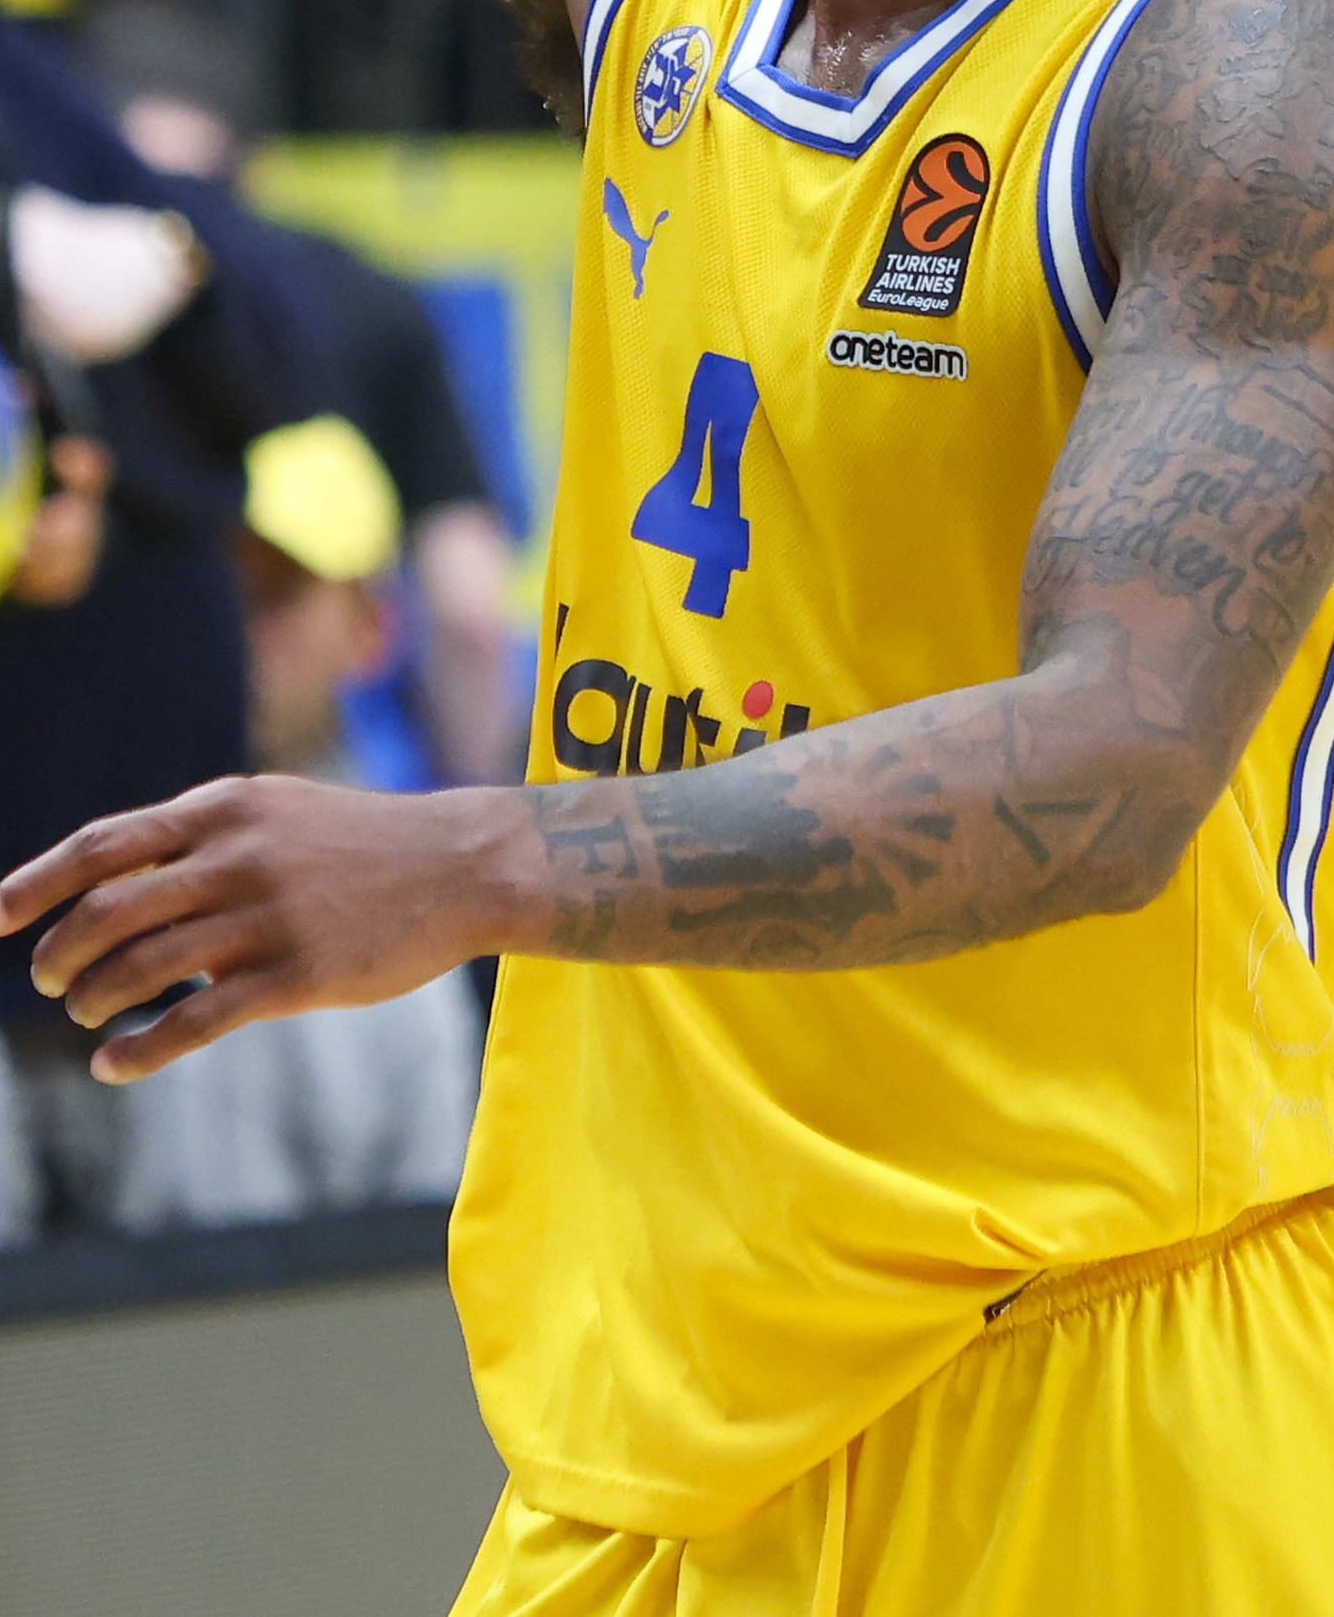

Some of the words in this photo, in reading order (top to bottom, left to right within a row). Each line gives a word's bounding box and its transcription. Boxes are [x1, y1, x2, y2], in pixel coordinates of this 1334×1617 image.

[886, 254, 961, 275] TURKISH
[875, 272, 956, 295] AIRLINES
[867, 289, 949, 311] EuroLeague
[829, 333, 964, 378] oneteam
[630, 351, 760, 619] 4
